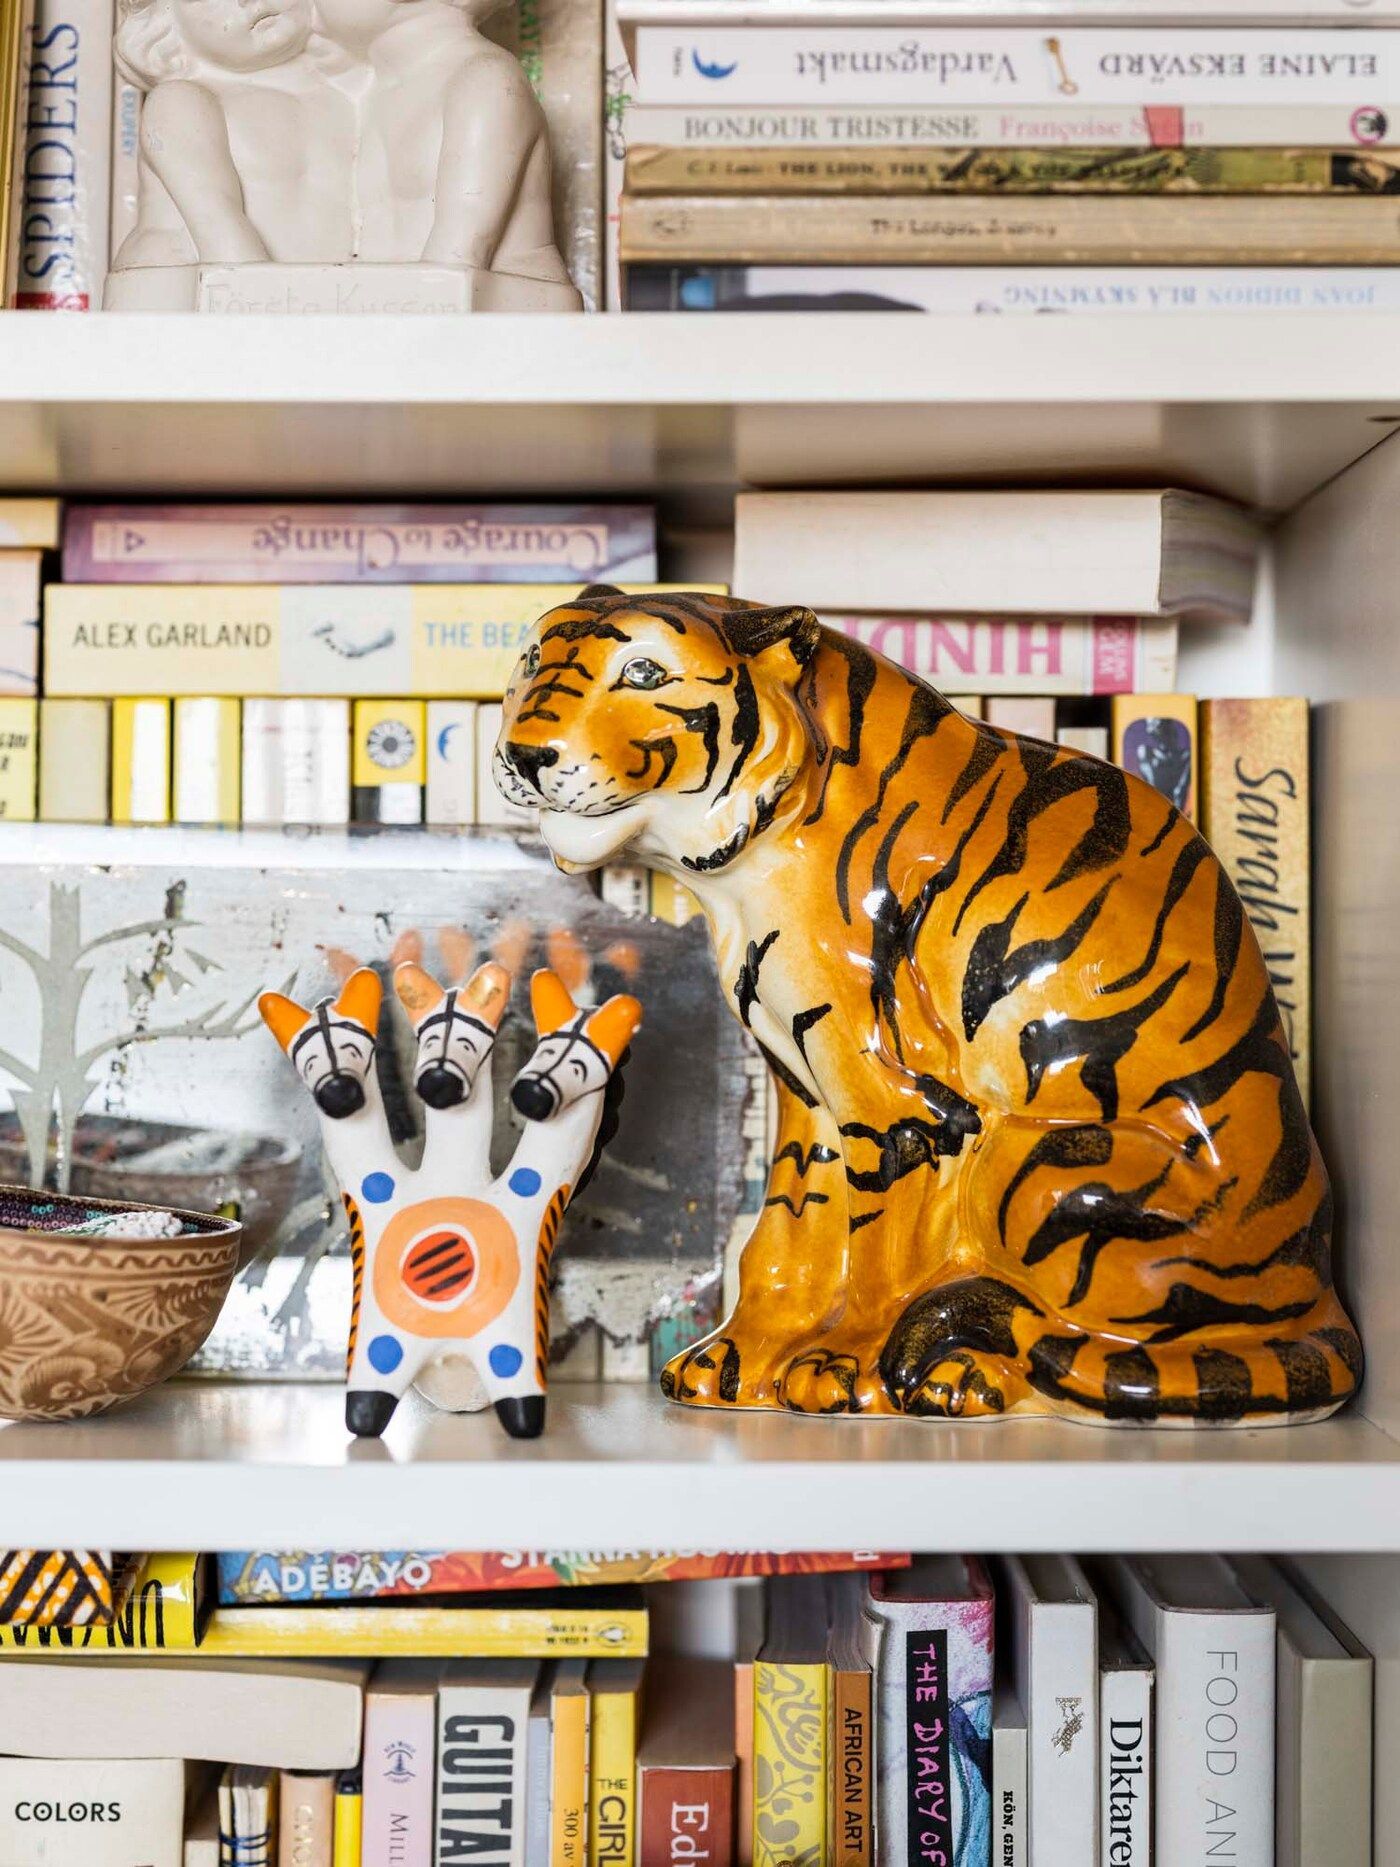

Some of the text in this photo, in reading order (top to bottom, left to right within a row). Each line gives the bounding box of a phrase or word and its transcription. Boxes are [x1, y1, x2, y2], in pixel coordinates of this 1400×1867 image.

[795, 40, 1017, 84] Vardagsmakt
[1100, 53, 1377, 84] ELAINE EKSVÄRD
[685, 115, 978, 138] BONJOUR TRISTESSE
[999, 117, 1121, 142] Françoise
[23, 22, 79, 280] SPIDERS
[1003, 285, 1139, 306] SKYMNING
[1208, 285, 1301, 306] DIDION
[1314, 285, 1376, 306] JOAN
[252, 516, 601, 575] Courage to Change
[73, 623, 271, 648] ALEX GARLAND
[424, 622, 473, 648] THE
[842, 620, 1063, 676] HIND
[1235, 756, 1300, 933] Sarah
[913, 1643, 947, 1867] THE DIARY OF
[1205, 1651, 1237, 1867] FOOD AN
[598, 1779, 627, 1790] THE
[844, 1708, 863, 1852] AFRICAN ART
[15, 1801, 121, 1822] COLORS
[1002, 1790, 1016, 1830] KÖN,
[563, 1808, 579, 1860] 300 av
[671, 1800, 710, 1867] Ed
